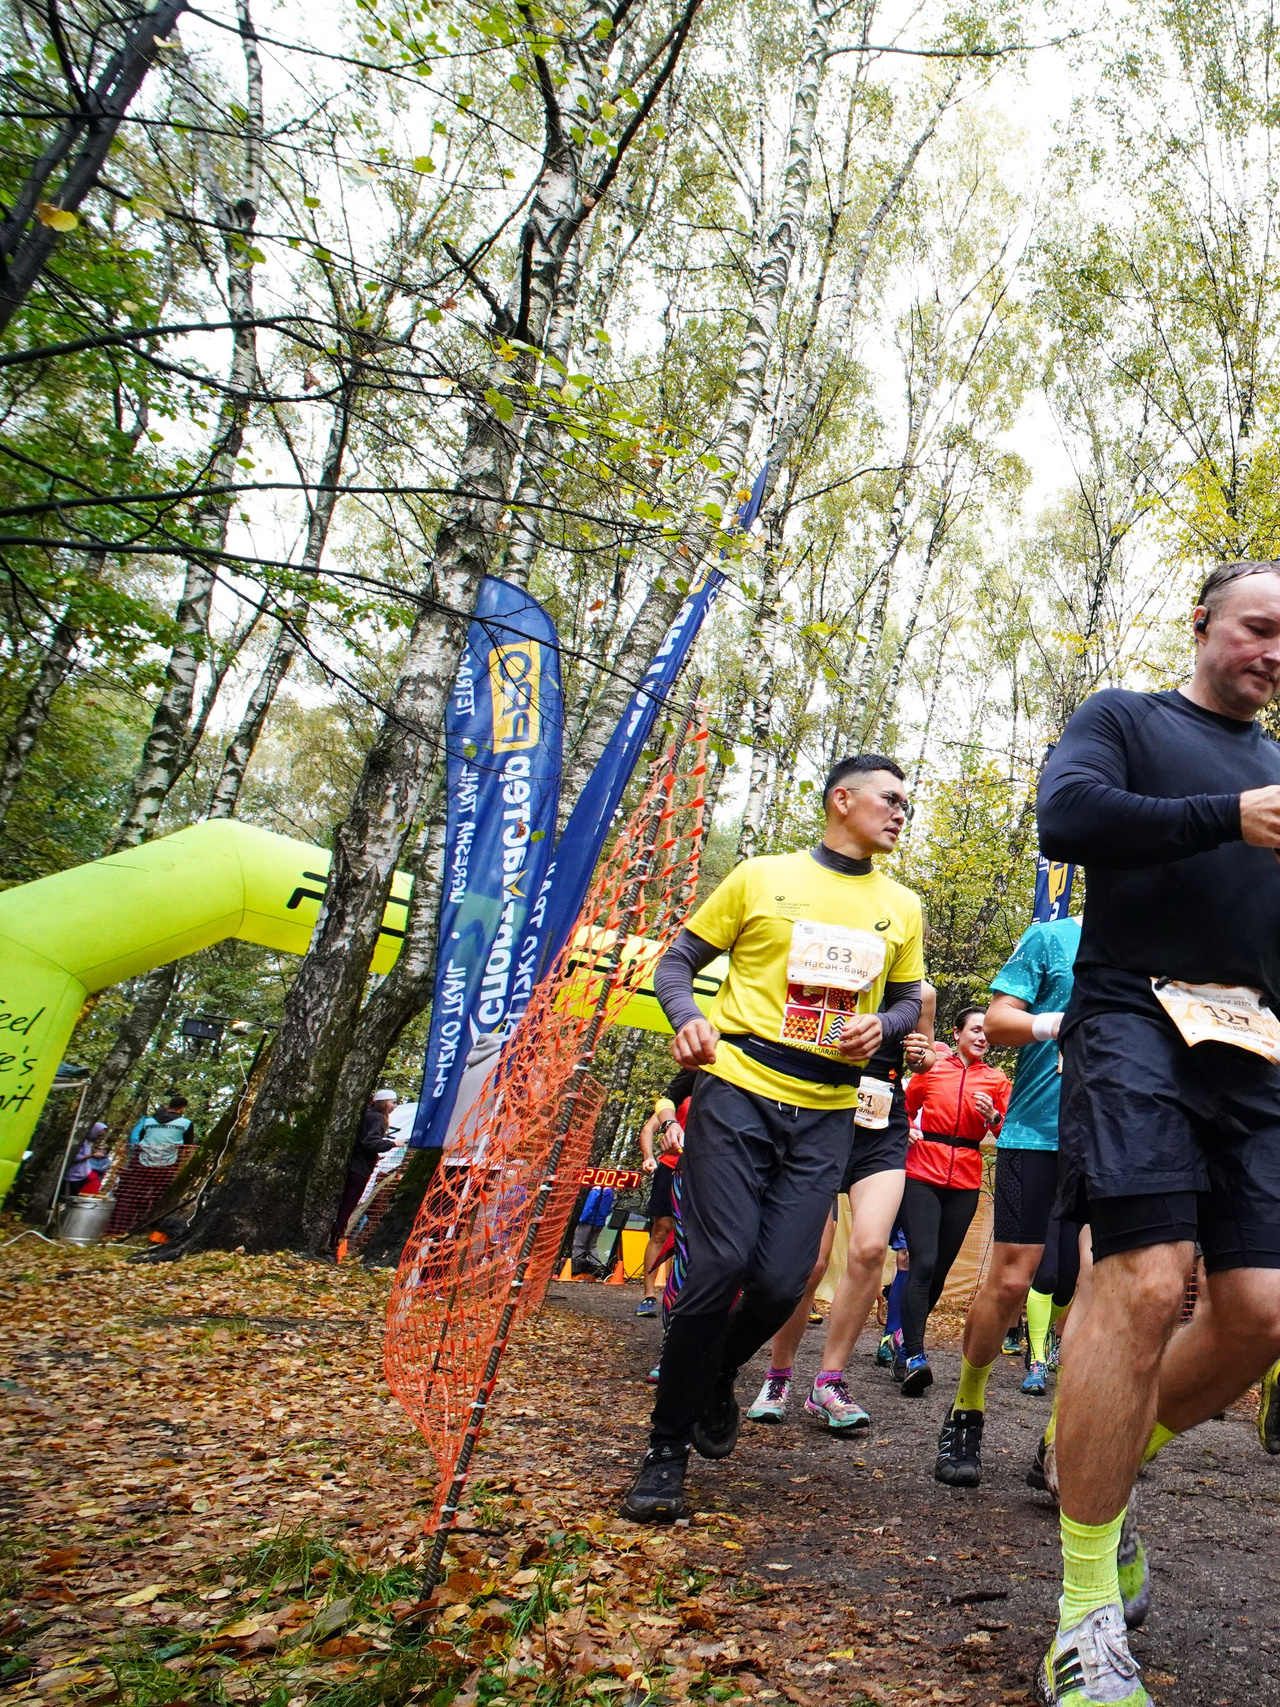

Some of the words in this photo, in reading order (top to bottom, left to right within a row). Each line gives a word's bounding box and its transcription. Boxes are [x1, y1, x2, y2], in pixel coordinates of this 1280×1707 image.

[827, 946, 852, 963] 63
[0, 1045, 38, 1076] e's
[814, 1046, 849, 1058] MARATHO
